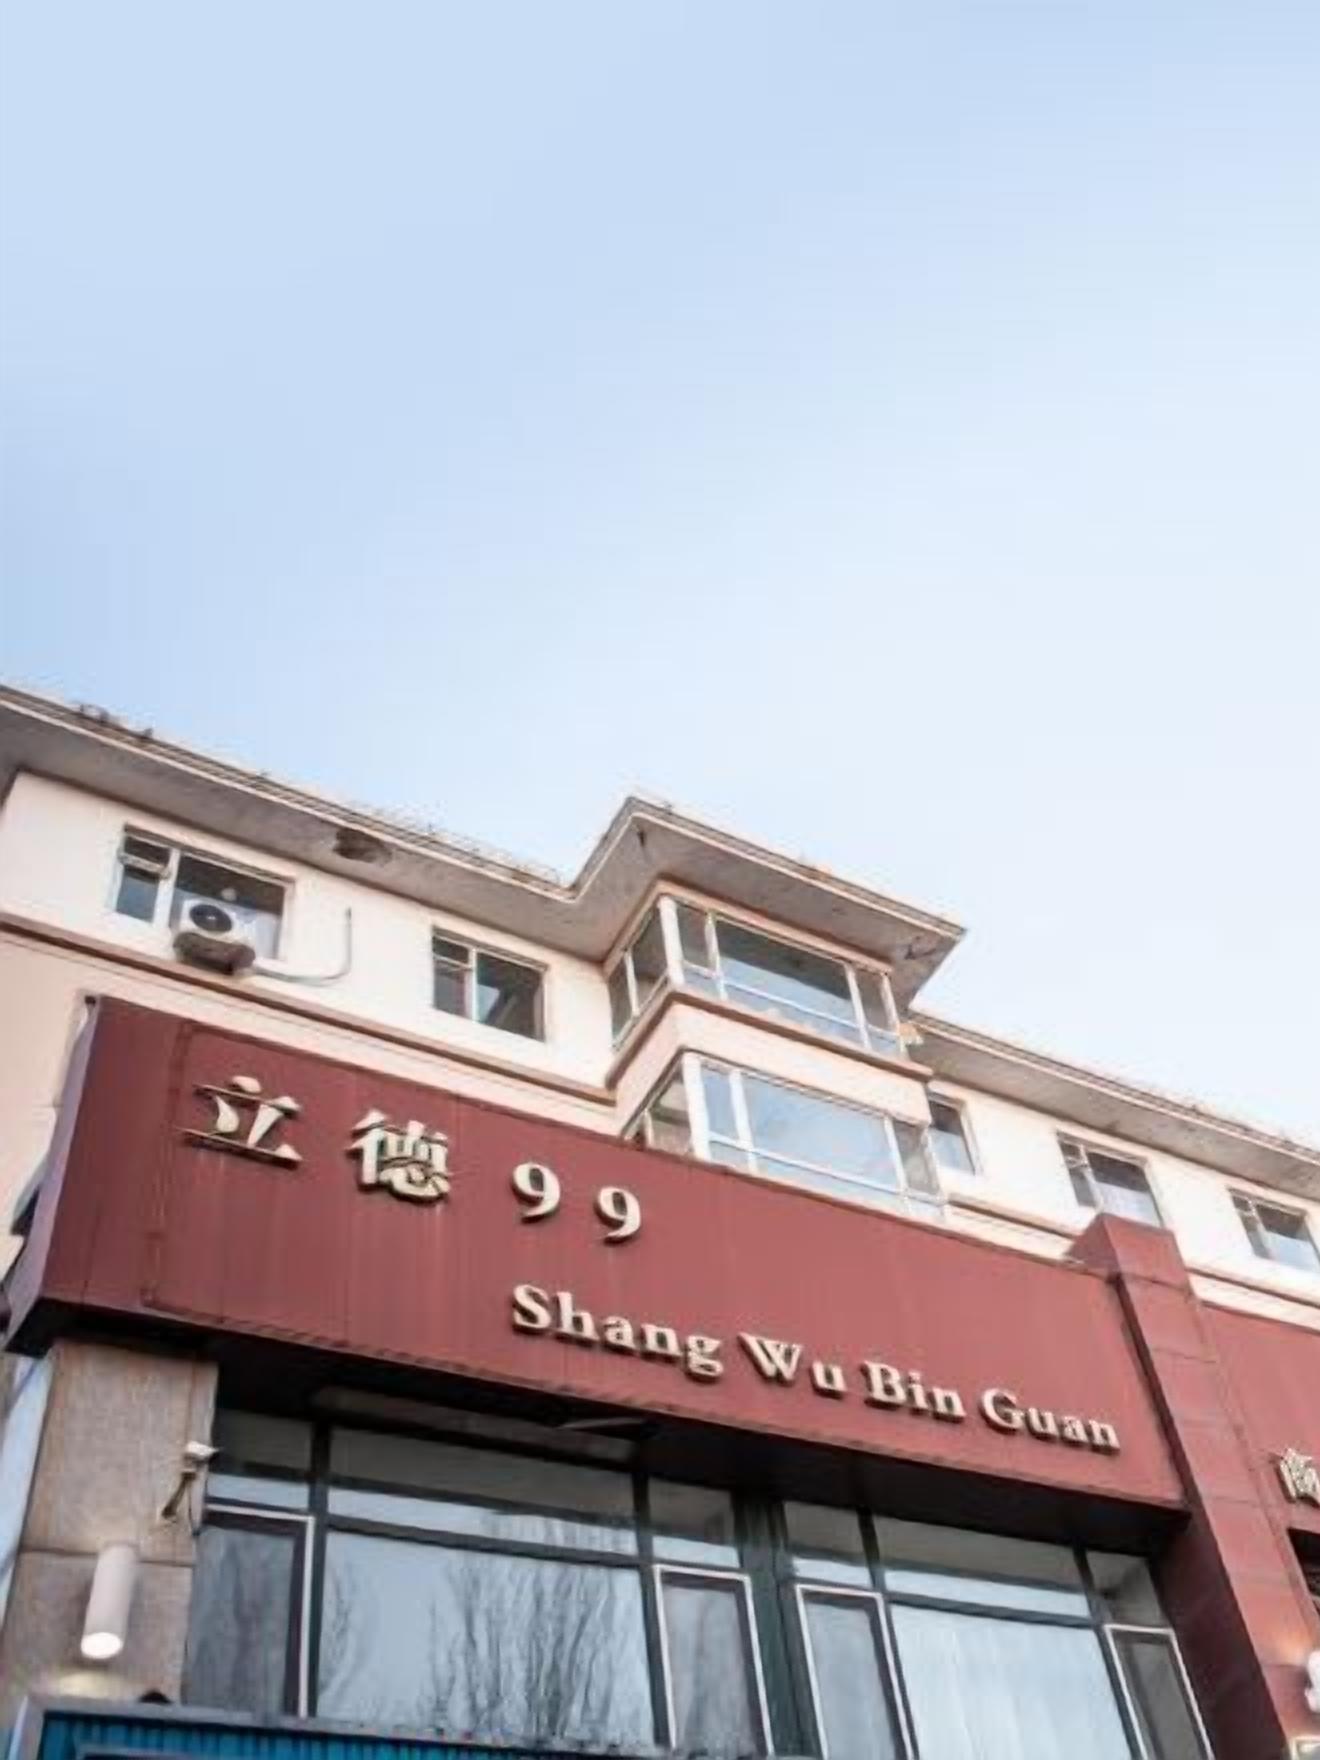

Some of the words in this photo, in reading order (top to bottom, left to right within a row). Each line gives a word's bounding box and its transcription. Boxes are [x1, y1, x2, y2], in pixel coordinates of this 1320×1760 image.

[512, 1284, 724, 1381] Shang
[738, 1332, 846, 1396] Wu
[864, 1359, 966, 1422] Bin
[980, 1387, 1120, 1455] Guan
